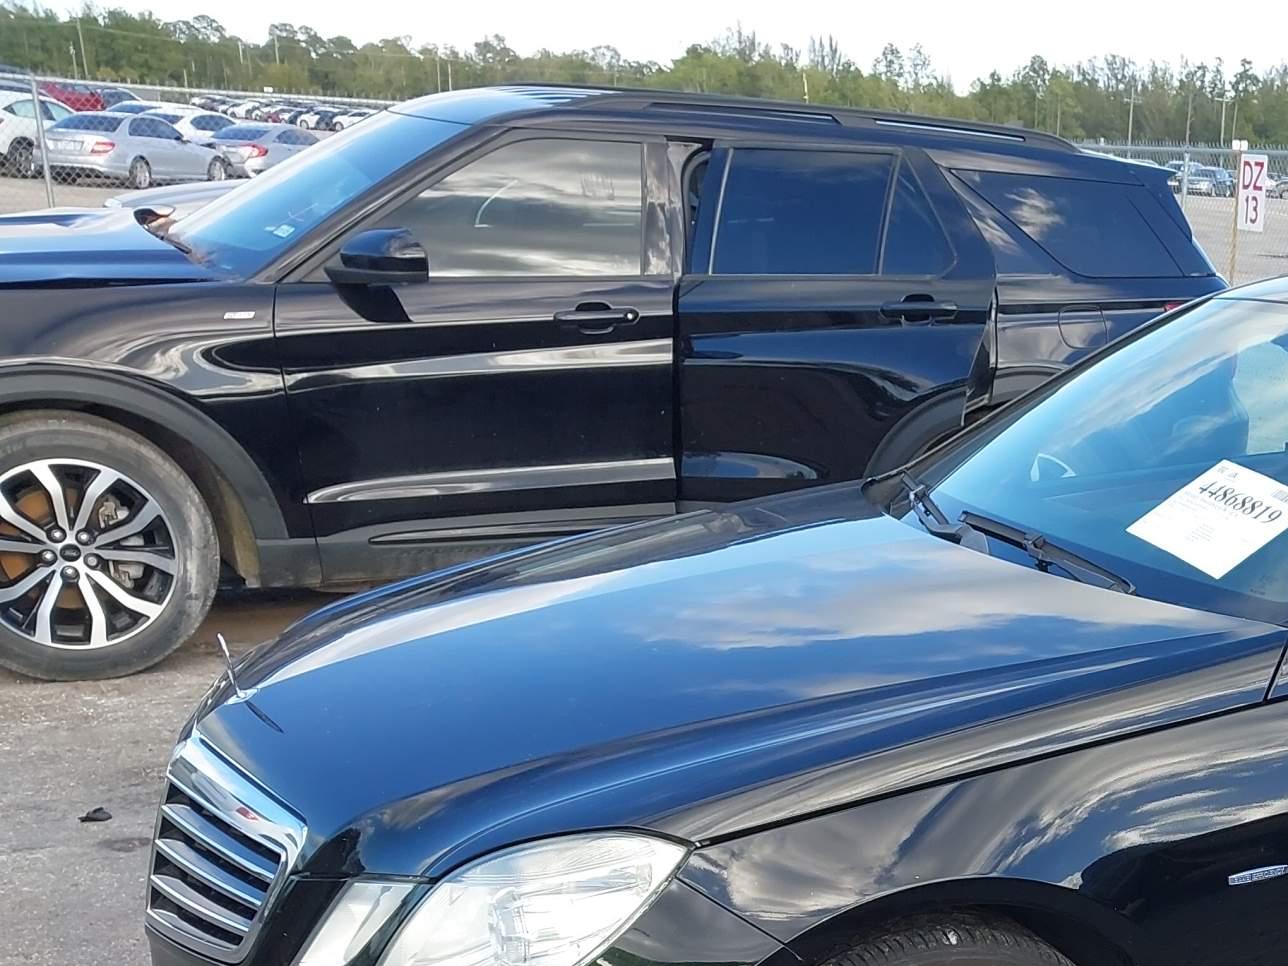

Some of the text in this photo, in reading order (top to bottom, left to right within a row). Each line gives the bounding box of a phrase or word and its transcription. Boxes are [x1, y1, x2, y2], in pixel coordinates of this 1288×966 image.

[1242, 160, 1265, 191] DZ
[1244, 195, 1259, 225] 13
[1198, 480, 1283, 524] 44868819
